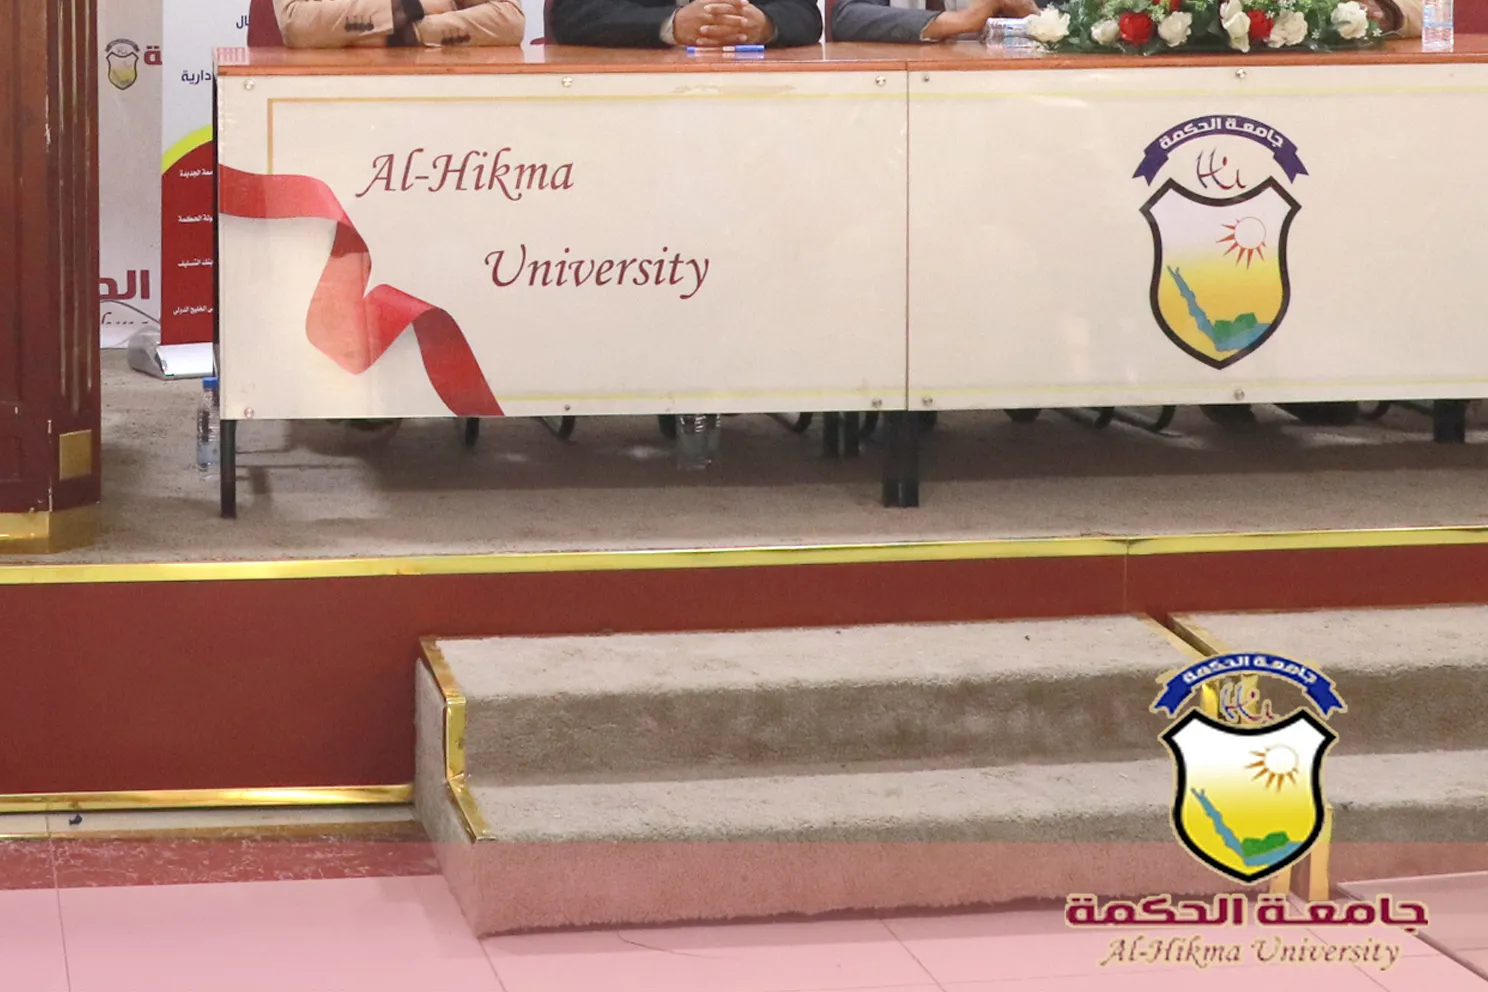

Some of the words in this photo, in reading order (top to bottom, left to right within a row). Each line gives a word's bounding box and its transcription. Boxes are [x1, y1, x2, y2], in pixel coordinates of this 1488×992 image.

[1159, 117, 1222, 150] الحكمة
[1224, 118, 1285, 150] جامعة
[356, 146, 576, 201] Al-Hikma
[483, 243, 710, 300] University
